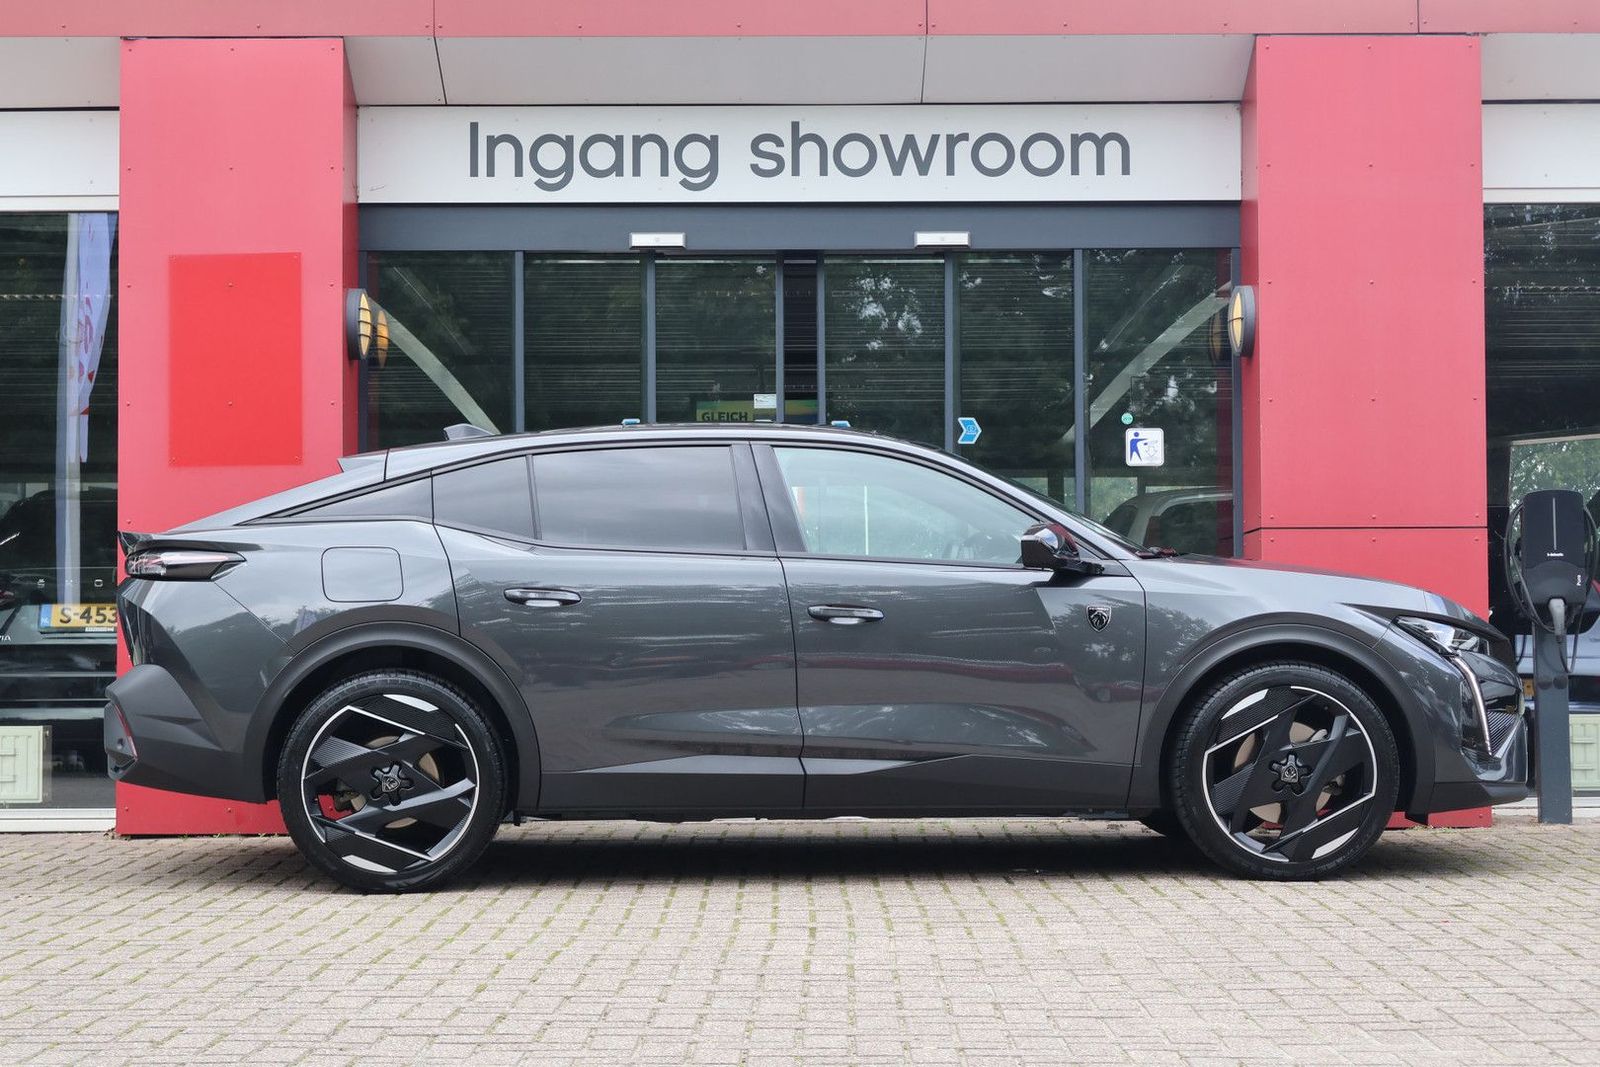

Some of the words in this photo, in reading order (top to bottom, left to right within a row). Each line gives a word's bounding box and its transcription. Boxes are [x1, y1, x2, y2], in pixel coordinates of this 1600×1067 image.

[470, 122, 718, 191] Ingang
[751, 121, 1130, 177] showroom
[702, 411, 749, 422] GLEICH
